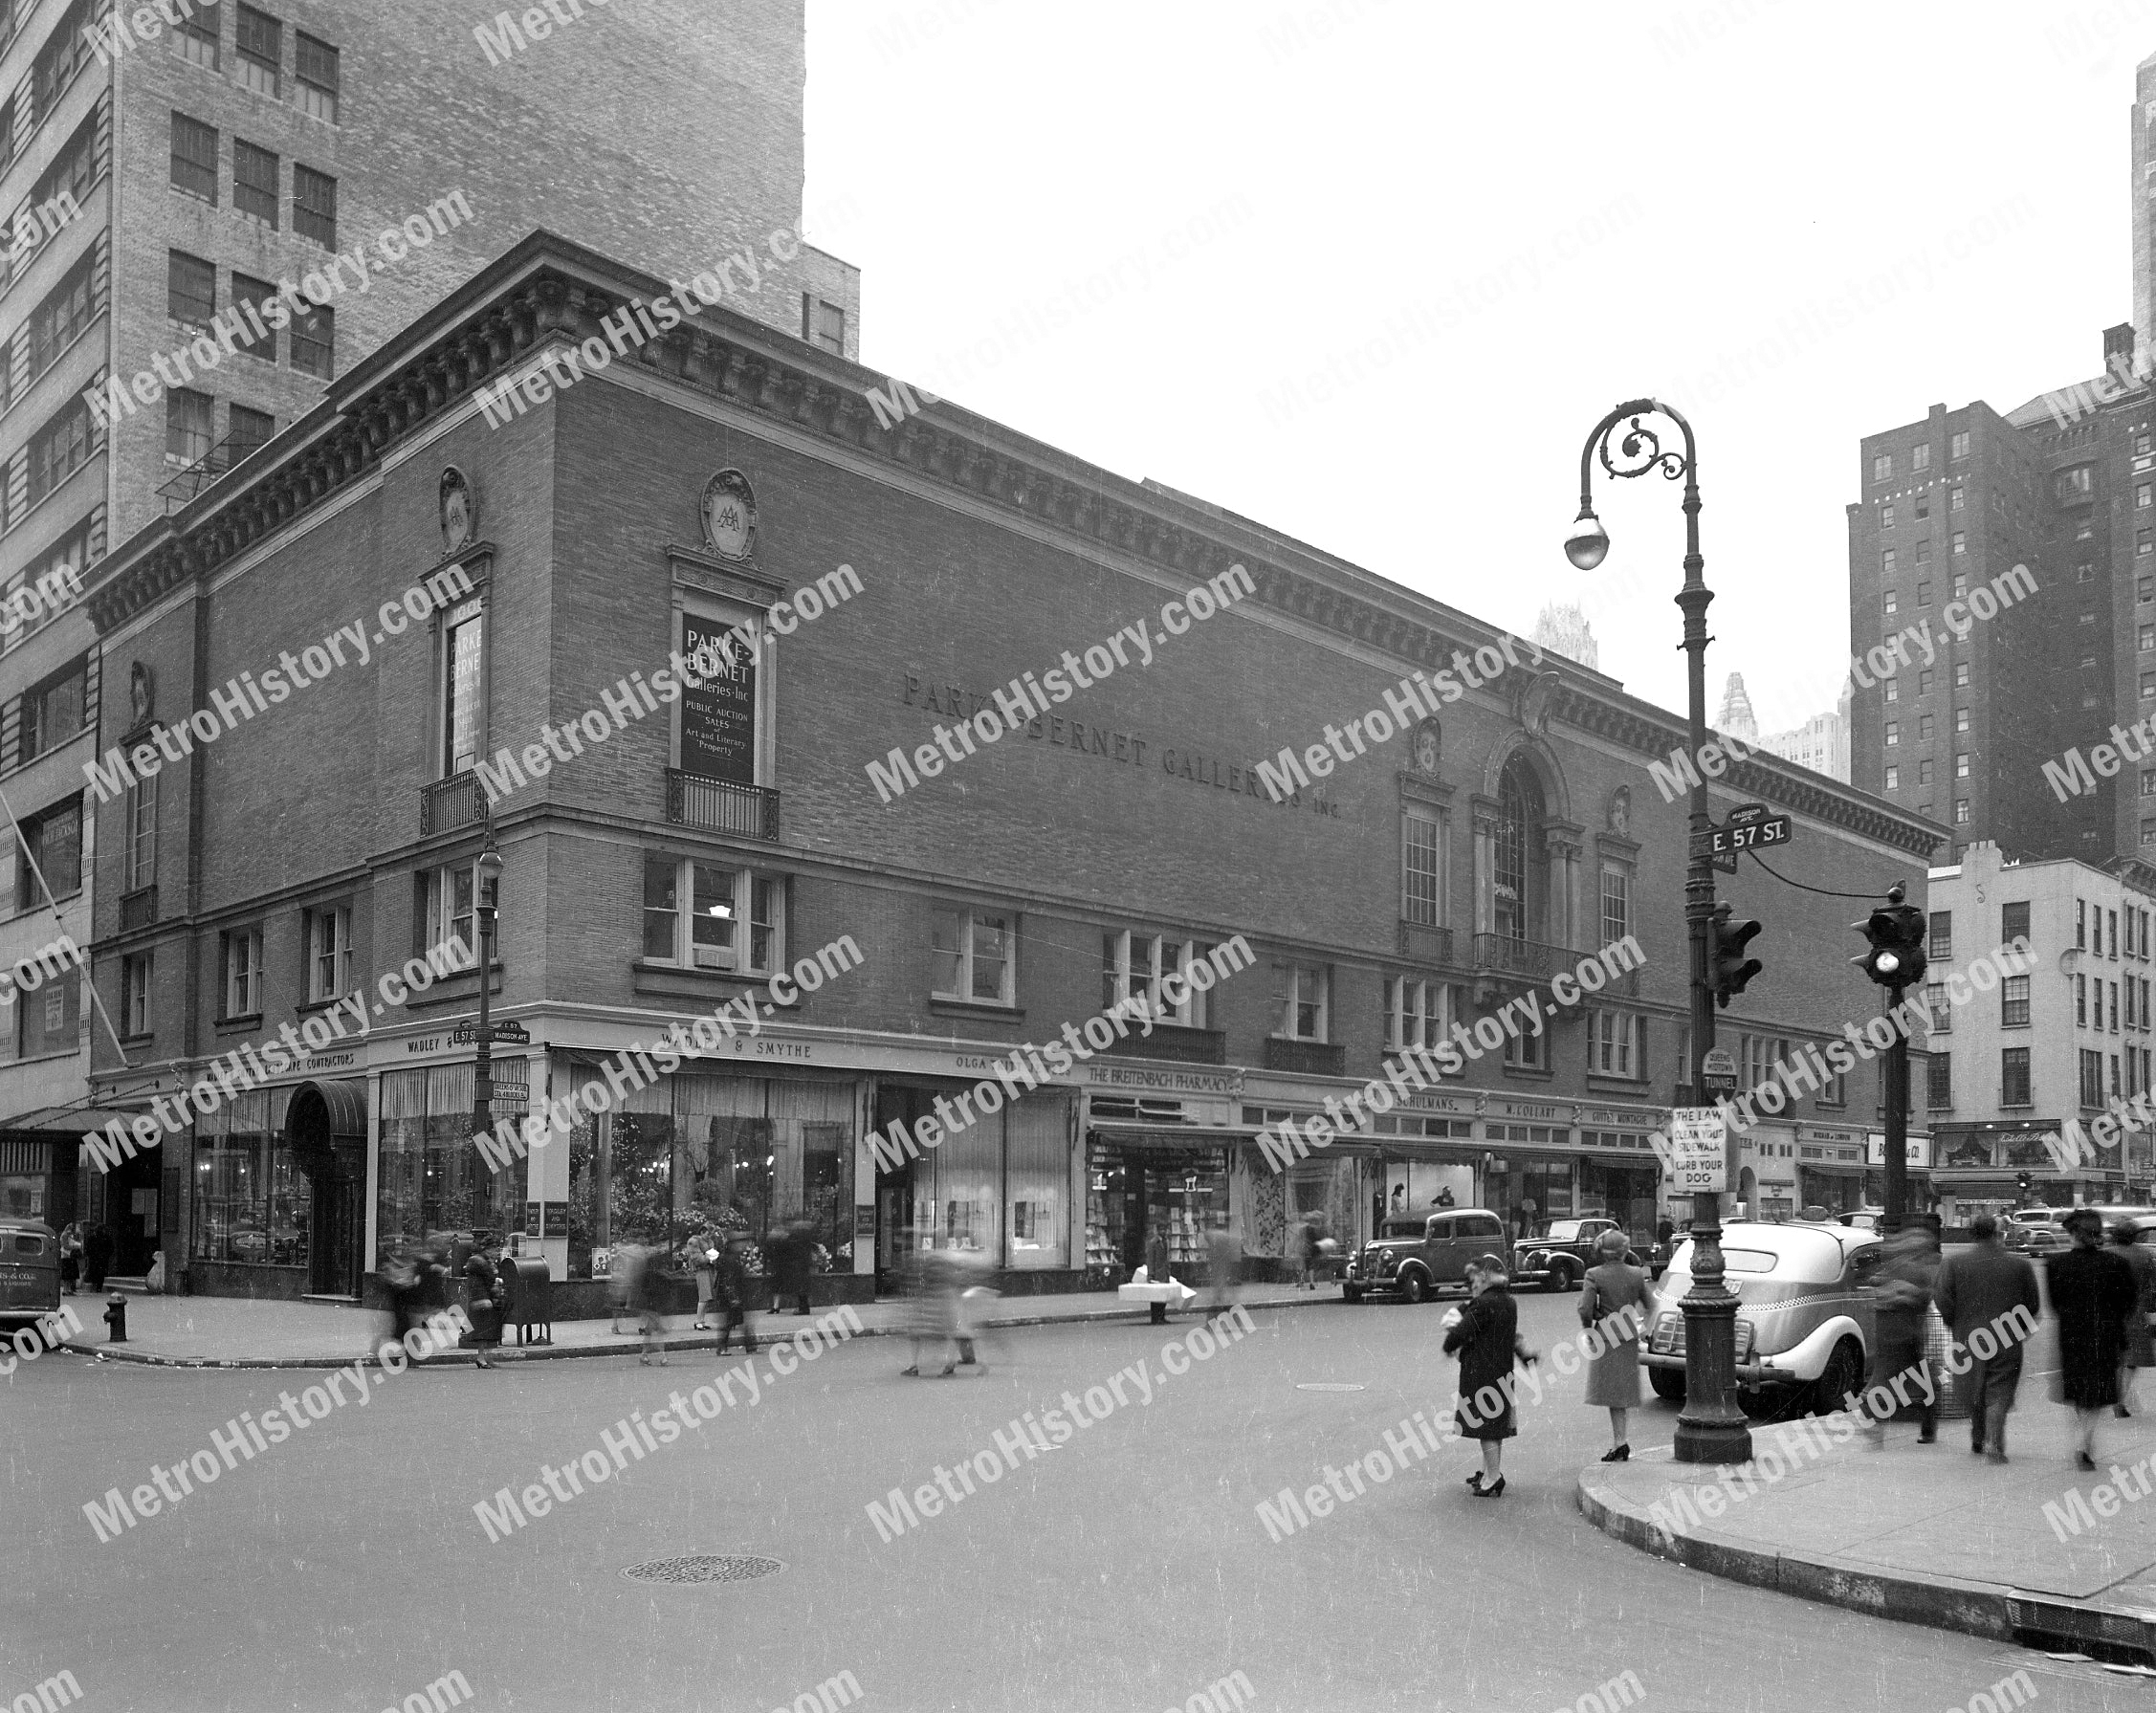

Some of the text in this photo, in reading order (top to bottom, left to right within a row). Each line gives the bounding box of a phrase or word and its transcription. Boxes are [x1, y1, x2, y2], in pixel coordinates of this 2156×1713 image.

[687, 652, 748, 684] BERNET
[686, 700, 748, 722] PUBLIC AUCTION
[705, 716, 730, 729] SALES
[686, 728, 746, 750] Art and Literary
[697, 739, 733, 757] Property
[1731, 808, 1761, 820] MADISON
[1713, 821, 1785, 852] E. 57 ST.
[461, 1031, 469, 1041] 57
[407, 1038, 440, 1053] WADLEY
[735, 1040, 743, 1052] &
[757, 1042, 811, 1058] SMYTHE
[306, 1053, 355, 1069] CONTRACTORS
[956, 1056, 987, 1069] OLGA
[1709, 1053, 1731, 1062] QUEENS
[1707, 1063, 1733, 1071] MIDTOWN
[1089, 1067, 1227, 1092] THE BREITENBACH PHARMACY
[1705, 1076, 1736, 1089] TUNNEL
[1676, 1109, 1724, 1121] THE LAW
[1675, 1130, 1700, 1140] CLEAN
[1678, 1142, 1721, 1153] SIDEWALK
[1676, 1160, 1723, 1171] CURB YOUR
[1686, 1173, 1712, 1183] DOG
